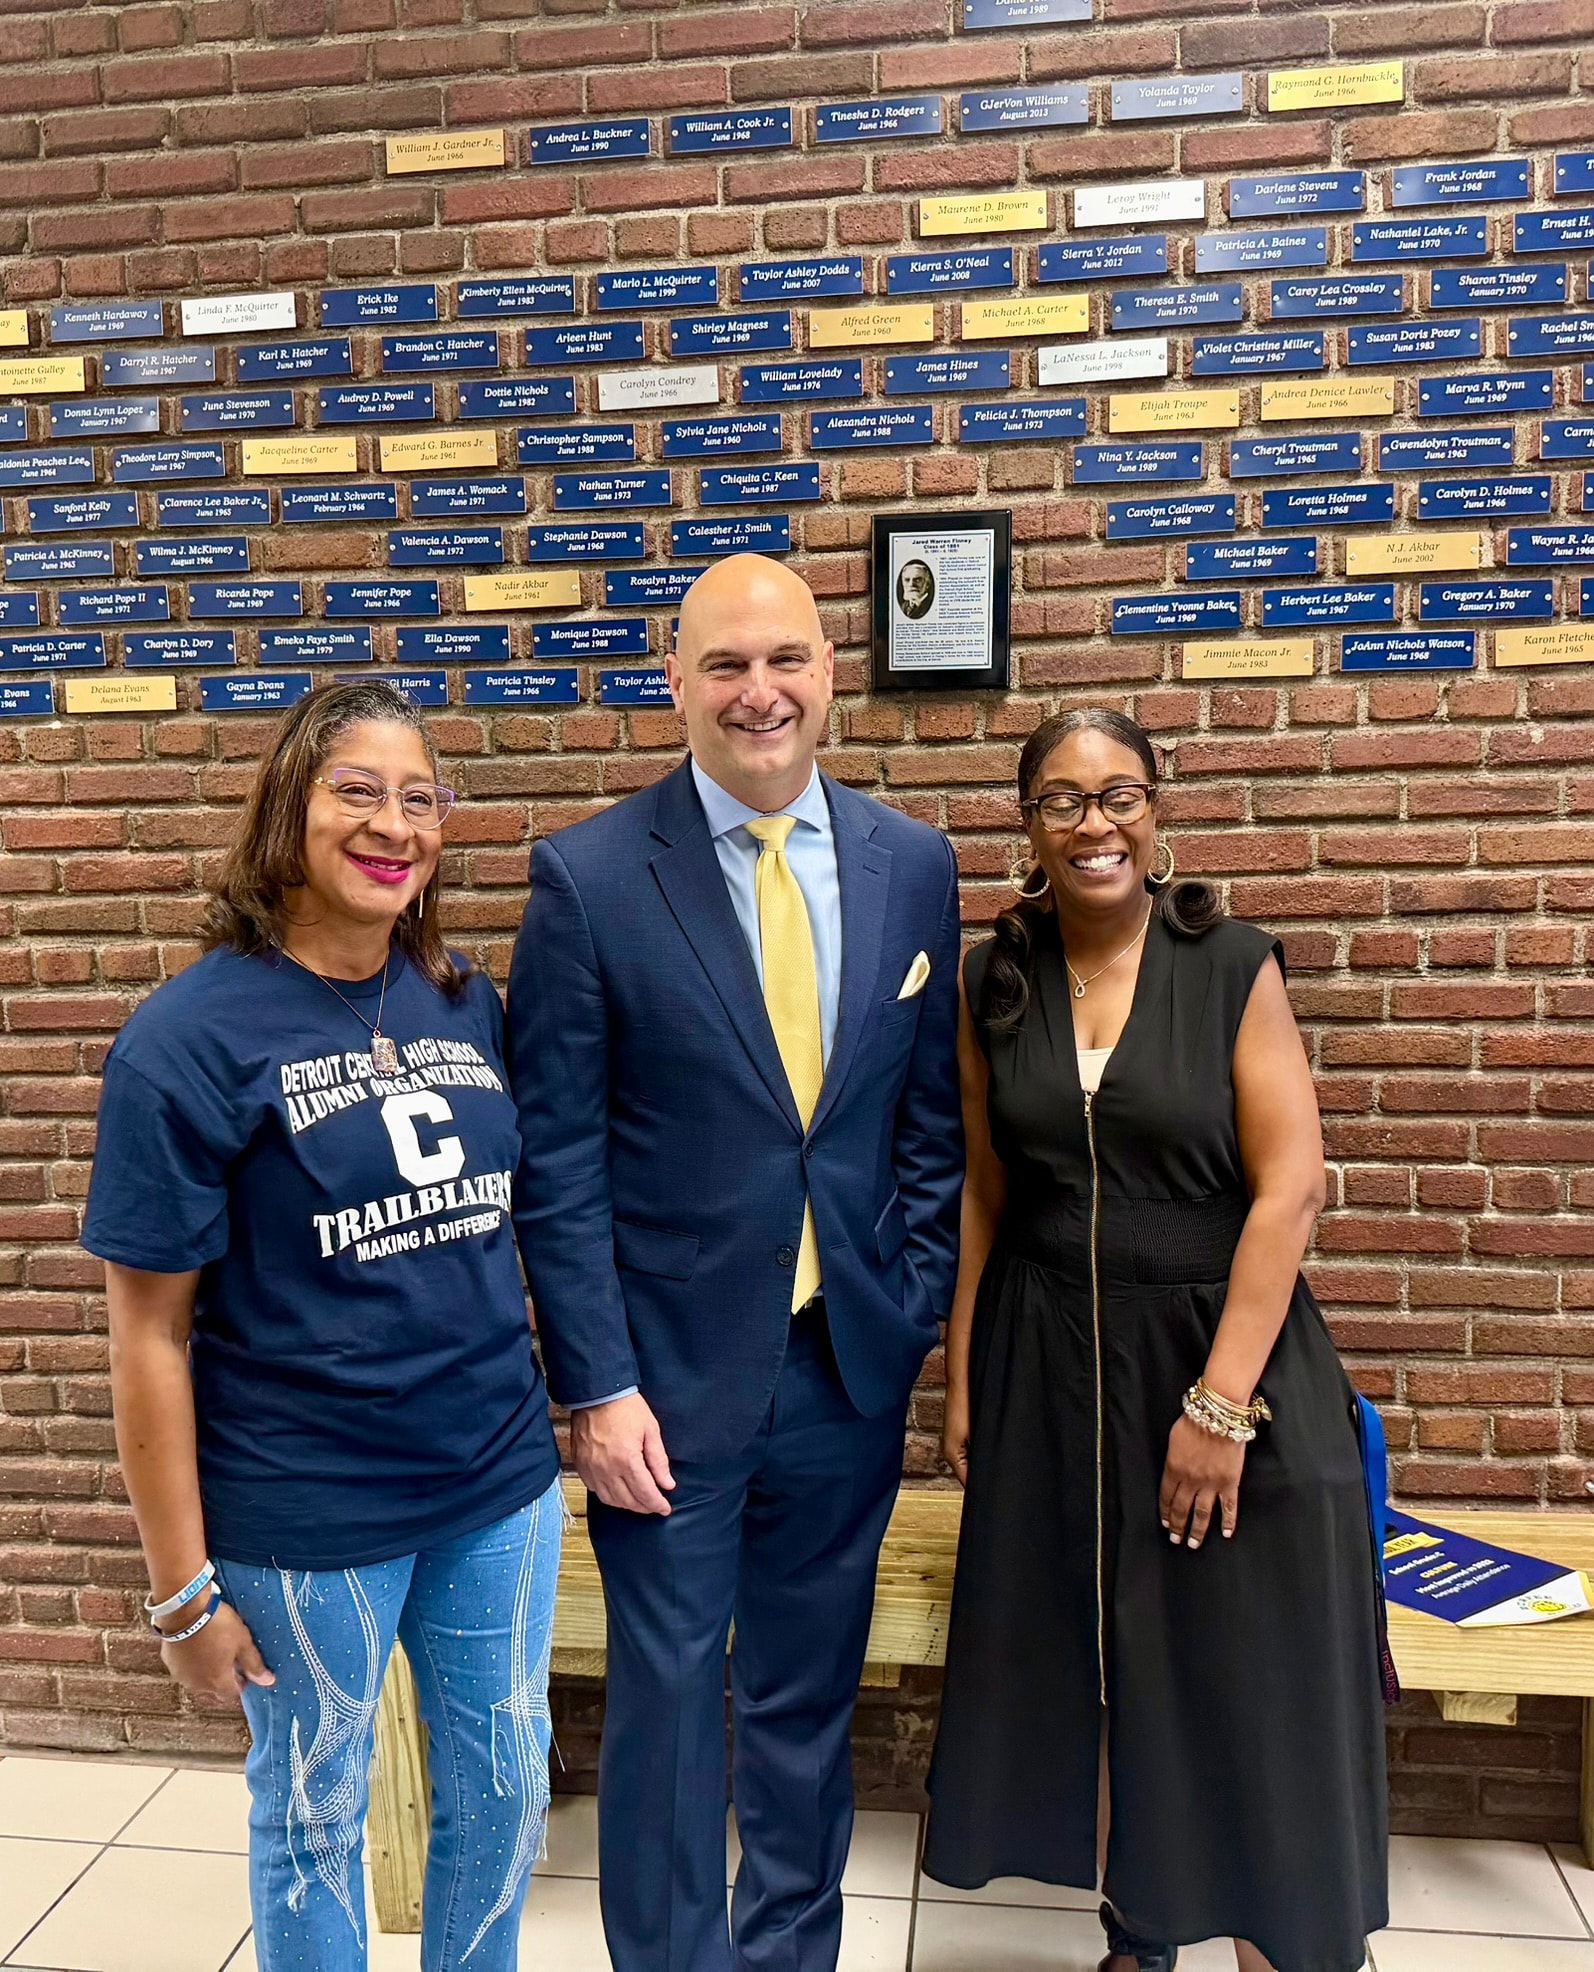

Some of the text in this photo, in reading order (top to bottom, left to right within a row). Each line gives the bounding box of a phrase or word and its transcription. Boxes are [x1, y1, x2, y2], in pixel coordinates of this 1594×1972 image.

[1139, 83, 1215, 97] Yolanda Taylor
[1025, 95, 1068, 106] Williams
[1156, 96, 1197, 107] June 1969
[830, 106, 924, 121] Tinesha D. Rodgers
[999, 107, 1048, 120] August 2013
[686, 116, 774, 132] William A. Cook Jr.
[857, 119, 897, 130] June 1966
[545, 128, 632, 143] Andrea L. Buckner
[711, 130, 750, 141] June 1968
[396, 143, 430, 153] William
[442, 138, 481, 150] Gardner
[570, 141, 608, 152] June 1990
[1254, 181, 1337, 194] Darlene Stevens
[1275, 193, 1317, 204] June 1972
[938, 205, 980, 214] Maurene
[997, 201, 1028, 210] Brown
[963, 216, 982, 224] June
[1370, 224, 1467, 239] Nathaniel Lake, Jr.
[1397, 238, 1440, 249] June 1970
[1062, 244, 1141, 259] Sierra Y. Jordan
[1081, 257, 1122, 269] June 2012
[752, 264, 849, 281] Taylor Ashley Dodds
[781, 278, 820, 289] June 2007
[1458, 272, 1537, 285] Sharon Tinsley
[1468, 285, 1526, 296] January 1970
[982, 306, 1021, 318] Michael
[1037, 305, 1068, 314] Carter
[1005, 319, 1024, 327] June
[1366, 332, 1397, 342] Susan
[1399, 329, 1428, 340] Doris
[395, 338, 484, 352] Brandon C. Hatcher
[1392, 341, 1434, 352] June 1983
[120, 354, 197, 367] Darryl R. Hatcher
[421, 351, 457, 361] June 1971
[141, 366, 176, 376] June 1967
[827, 413, 914, 428] Alexandra Nichols
[852, 427, 891, 437] June 1988
[1097, 450, 1176, 462] Nina Y. Jackson
[1116, 462, 1157, 472] June 1989
[53, 501, 110, 513] Sanford Kelly
[1126, 503, 1214, 517] Carolyn Calloway
[66, 512, 100, 522] June 1977
[1150, 516, 1191, 527] June 1968
[149, 545, 233, 556] Wilma J. McKinney
[1213, 545, 1288, 558] Michael Baker
[170, 556, 213, 566] August 1966
[1230, 558, 1272, 568] June 1969
[1442, 588, 1531, 601] Gregory A. Baker
[1457, 601, 1515, 611] January 1970
[424, 633, 480, 643] Ella Dawson
[434, 645, 452, 653] June
[1203, 649, 1240, 658] Jimmie
[1243, 648, 1277, 657] Macon
[257, 680, 284, 689] Evans
[486, 675, 555, 685] Patricia Tinsley
[232, 691, 280, 701] January 1963
[503, 687, 520, 695] June
[281, 1038, 485, 1094] DETROIT CENL HIGH SCHOOL
[284, 1063, 504, 1135] ALUMNI ORGANIZATION
[380, 1089, 466, 1187] C
[313, 1170, 513, 1258] TRAILBLAZERS
[356, 1210, 501, 1263] MAKING A DIFFERENCE
